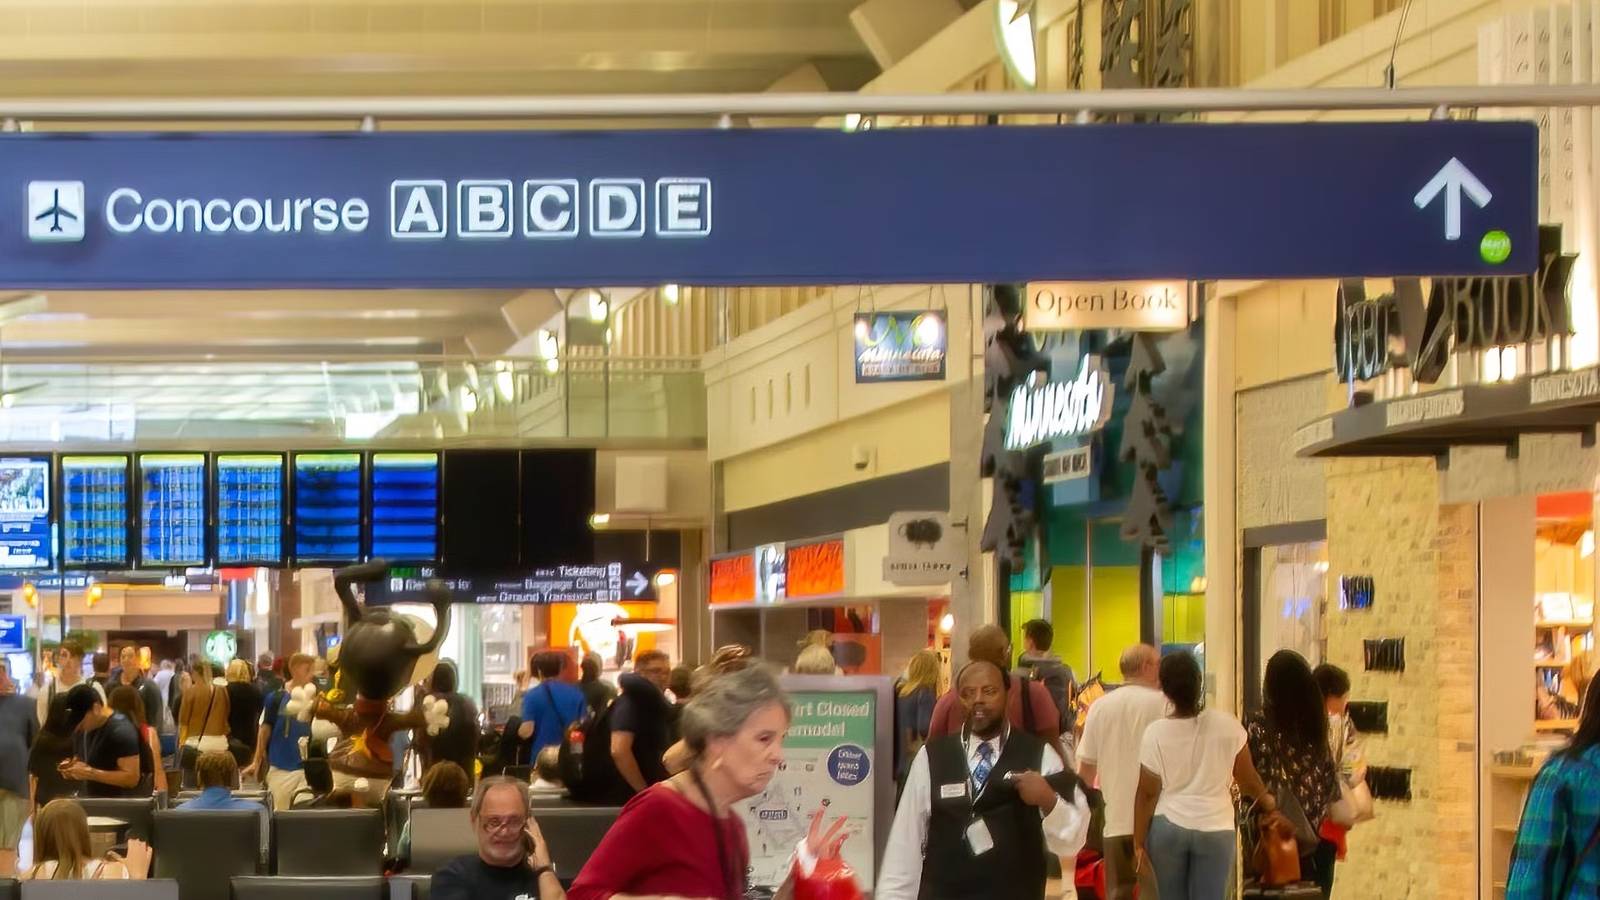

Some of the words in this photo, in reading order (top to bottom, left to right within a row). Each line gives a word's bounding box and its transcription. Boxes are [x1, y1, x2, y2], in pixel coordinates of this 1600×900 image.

[105, 187, 370, 233] Concourse
[398, 186, 440, 232] A
[468, 186, 506, 231] B
[529, 185, 571, 232] C
[599, 185, 638, 230] D
[667, 184, 701, 229] E
[1035, 289, 1104, 317] Open
[1112, 287, 1178, 312] Book
[817, 700, 869, 717] Closed
[786, 721, 845, 737] emodel
